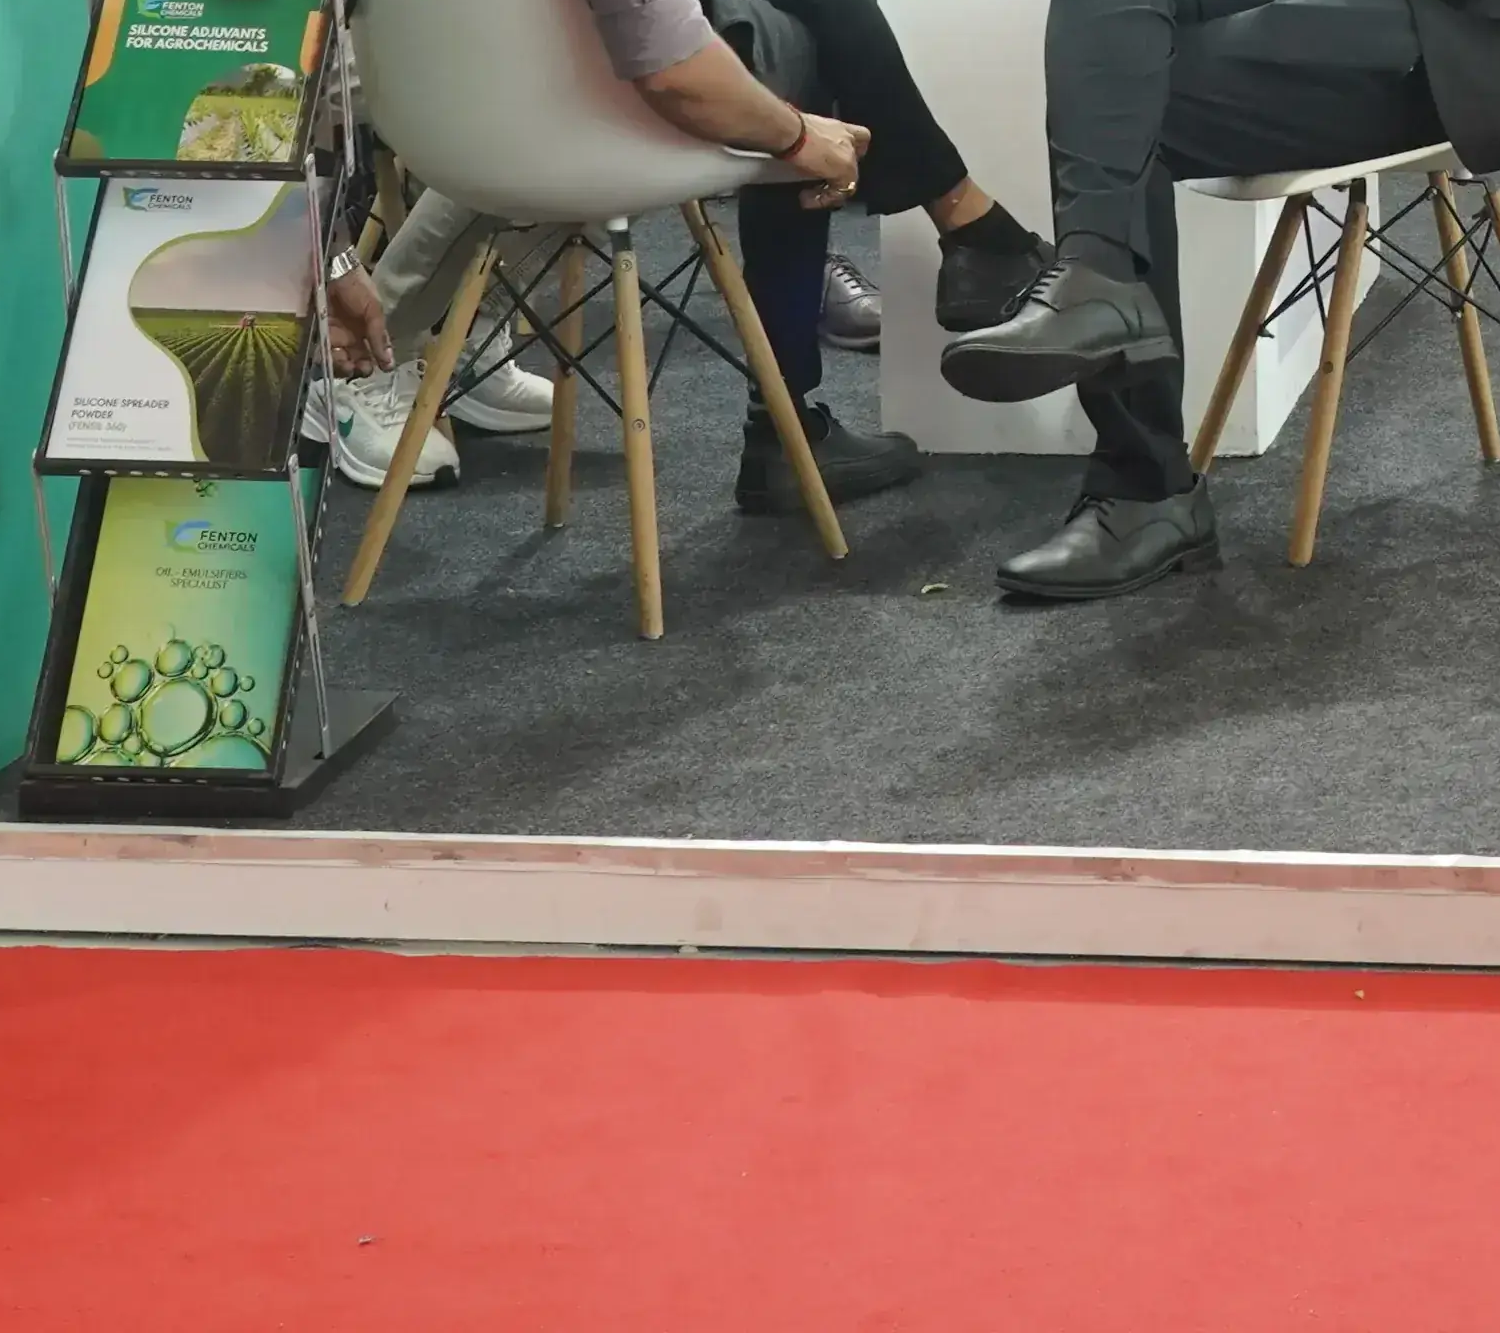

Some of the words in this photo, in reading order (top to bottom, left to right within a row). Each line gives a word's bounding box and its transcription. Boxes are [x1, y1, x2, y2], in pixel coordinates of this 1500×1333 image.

[162, 1, 204, 11] FENTON
[128, 24, 189, 37] SILICONE
[190, 26, 266, 40] ADJUVANTS
[126, 37, 152, 49] FOR
[154, 38, 269, 53] AGROCHEMICALS
[150, 194, 193, 203] FENTON
[73, 397, 117, 407] SILICONE
[120, 399, 170, 409] SPREADER
[71, 410, 114, 419] POWDER
[200, 530, 258, 543] FENTON
[197, 542, 255, 552] CHEMICALS
[182, 568, 248, 580] EMULSIFIERS
[170, 578, 228, 589] SPECIALIST
